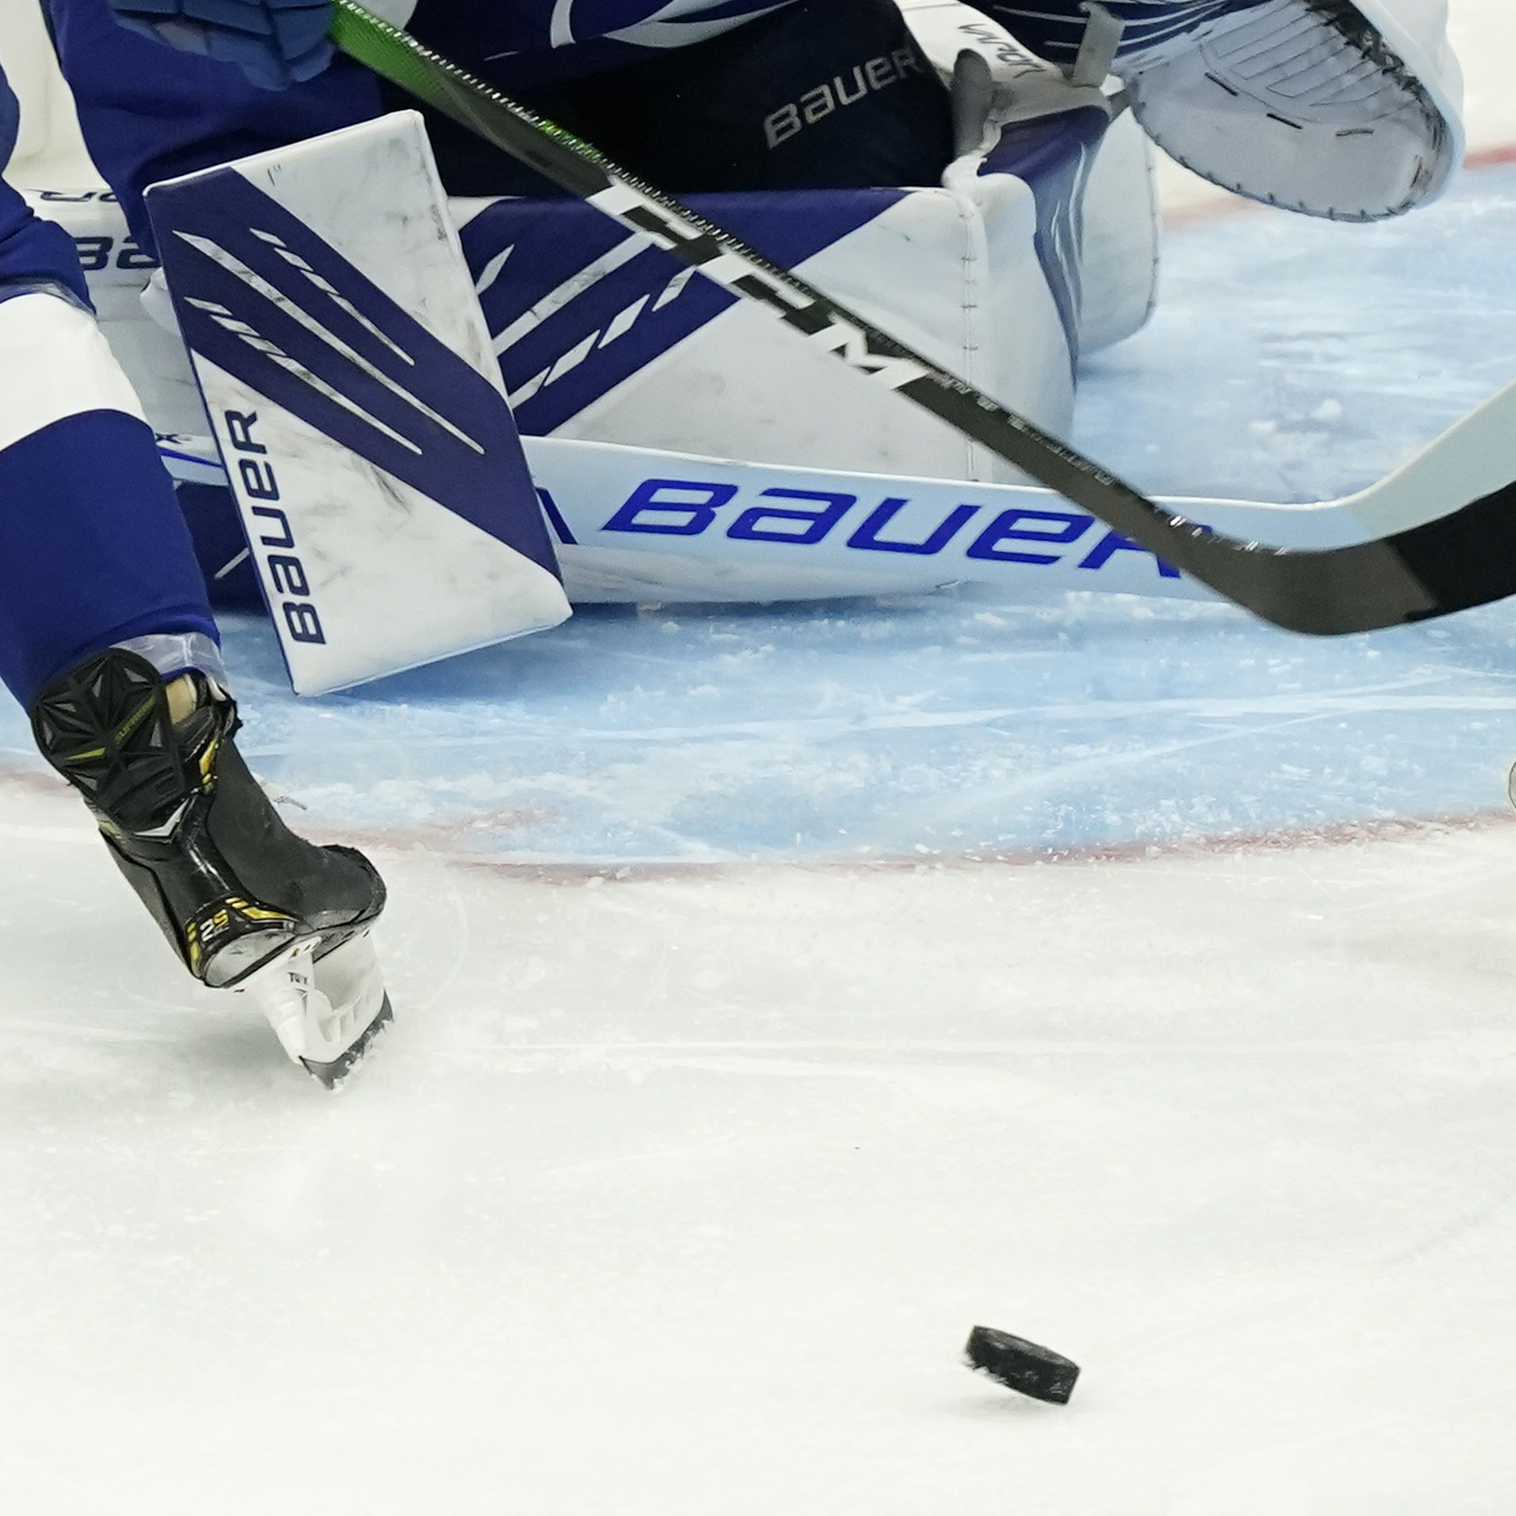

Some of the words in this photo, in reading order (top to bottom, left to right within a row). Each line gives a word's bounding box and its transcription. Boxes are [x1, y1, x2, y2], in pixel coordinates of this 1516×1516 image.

[762, 46, 928, 150] BAUER
[587, 181, 928, 391] CCM
[224, 408, 327, 646] BAUER
